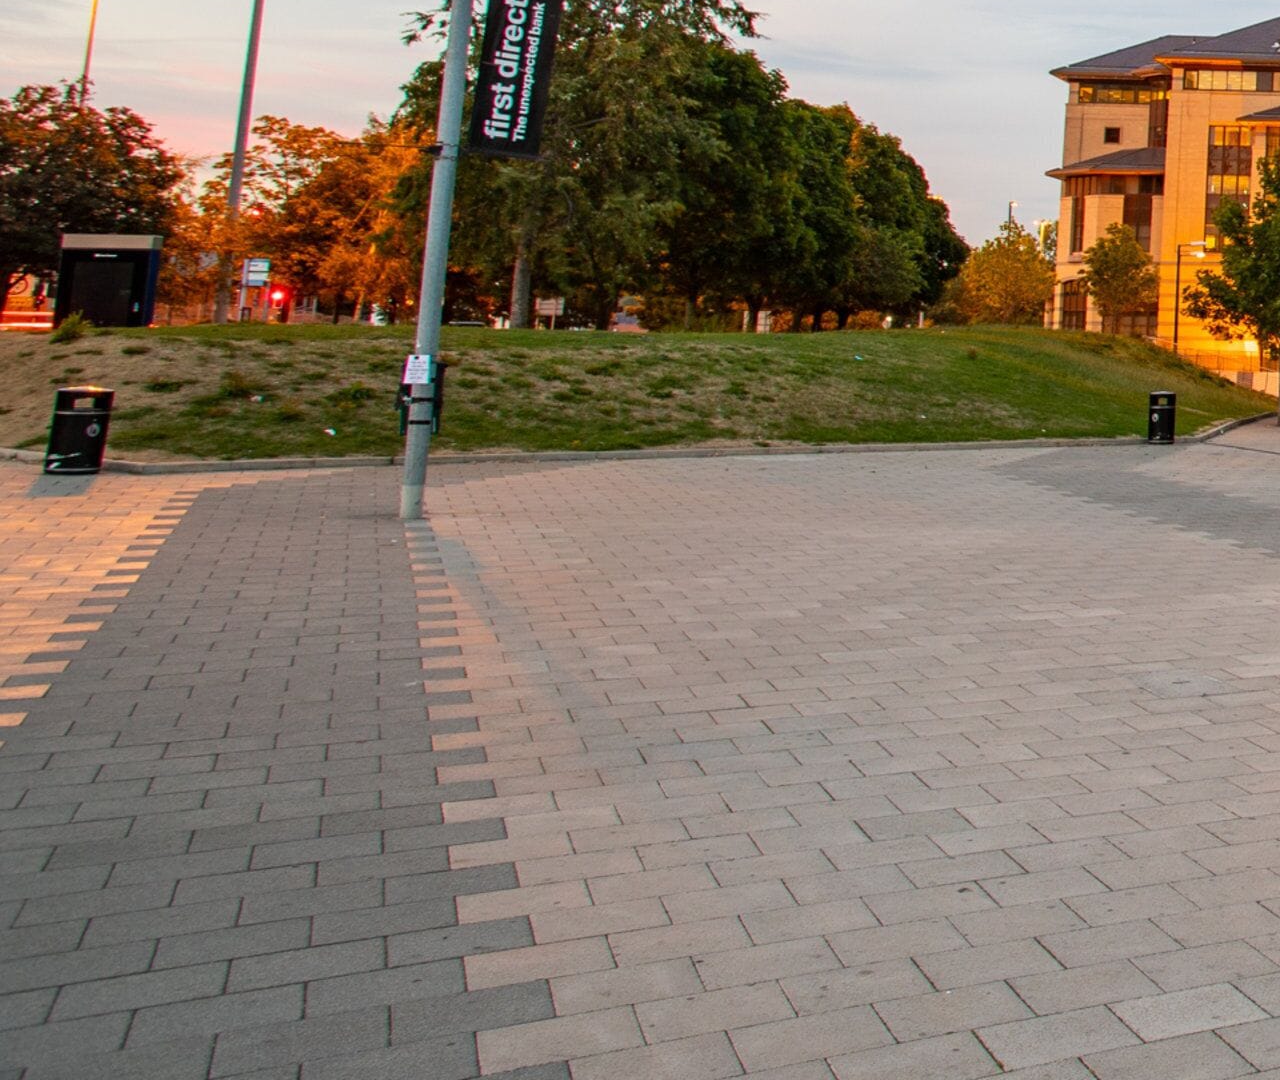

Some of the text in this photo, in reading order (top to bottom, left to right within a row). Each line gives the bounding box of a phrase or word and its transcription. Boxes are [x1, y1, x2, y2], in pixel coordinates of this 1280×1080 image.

[483, 81, 516, 139] first
[511, 1, 546, 142] The unexpected bank
